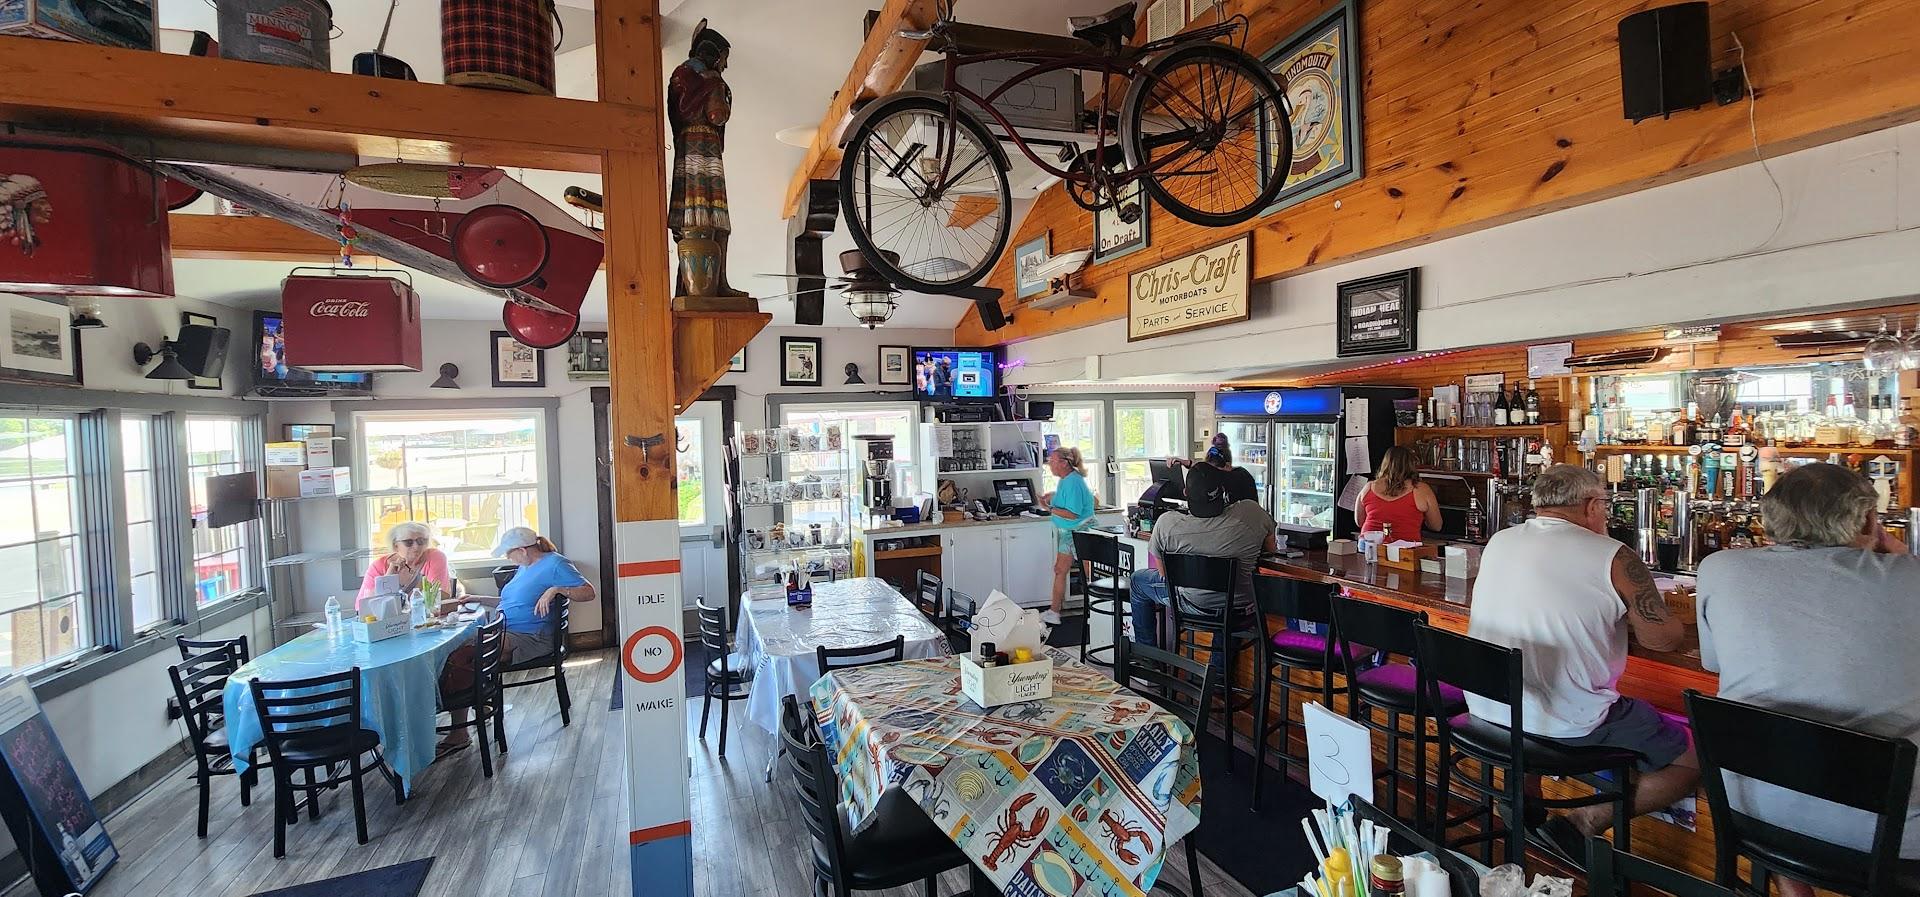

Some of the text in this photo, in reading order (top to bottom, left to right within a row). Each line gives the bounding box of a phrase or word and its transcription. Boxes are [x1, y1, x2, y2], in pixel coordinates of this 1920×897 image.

[1101, 228, 1136, 249] On Draft
[1135, 243, 1241, 303] Chris-Craft
[1159, 287, 1208, 305] MOTORBOATS
[1350, 305, 1377, 318] INDIAN
[1357, 318, 1393, 330] ROADHOUSE
[637, 593, 665, 605] IDLE
[644, 647, 662, 657] NO
[1007, 669, 1050, 686] Yuengling
[1015, 682, 1041, 694] LIGHT
[636, 698, 674, 713] WAKE
[1135, 730, 1163, 763] CATCH
[1312, 733, 1350, 786] 3
